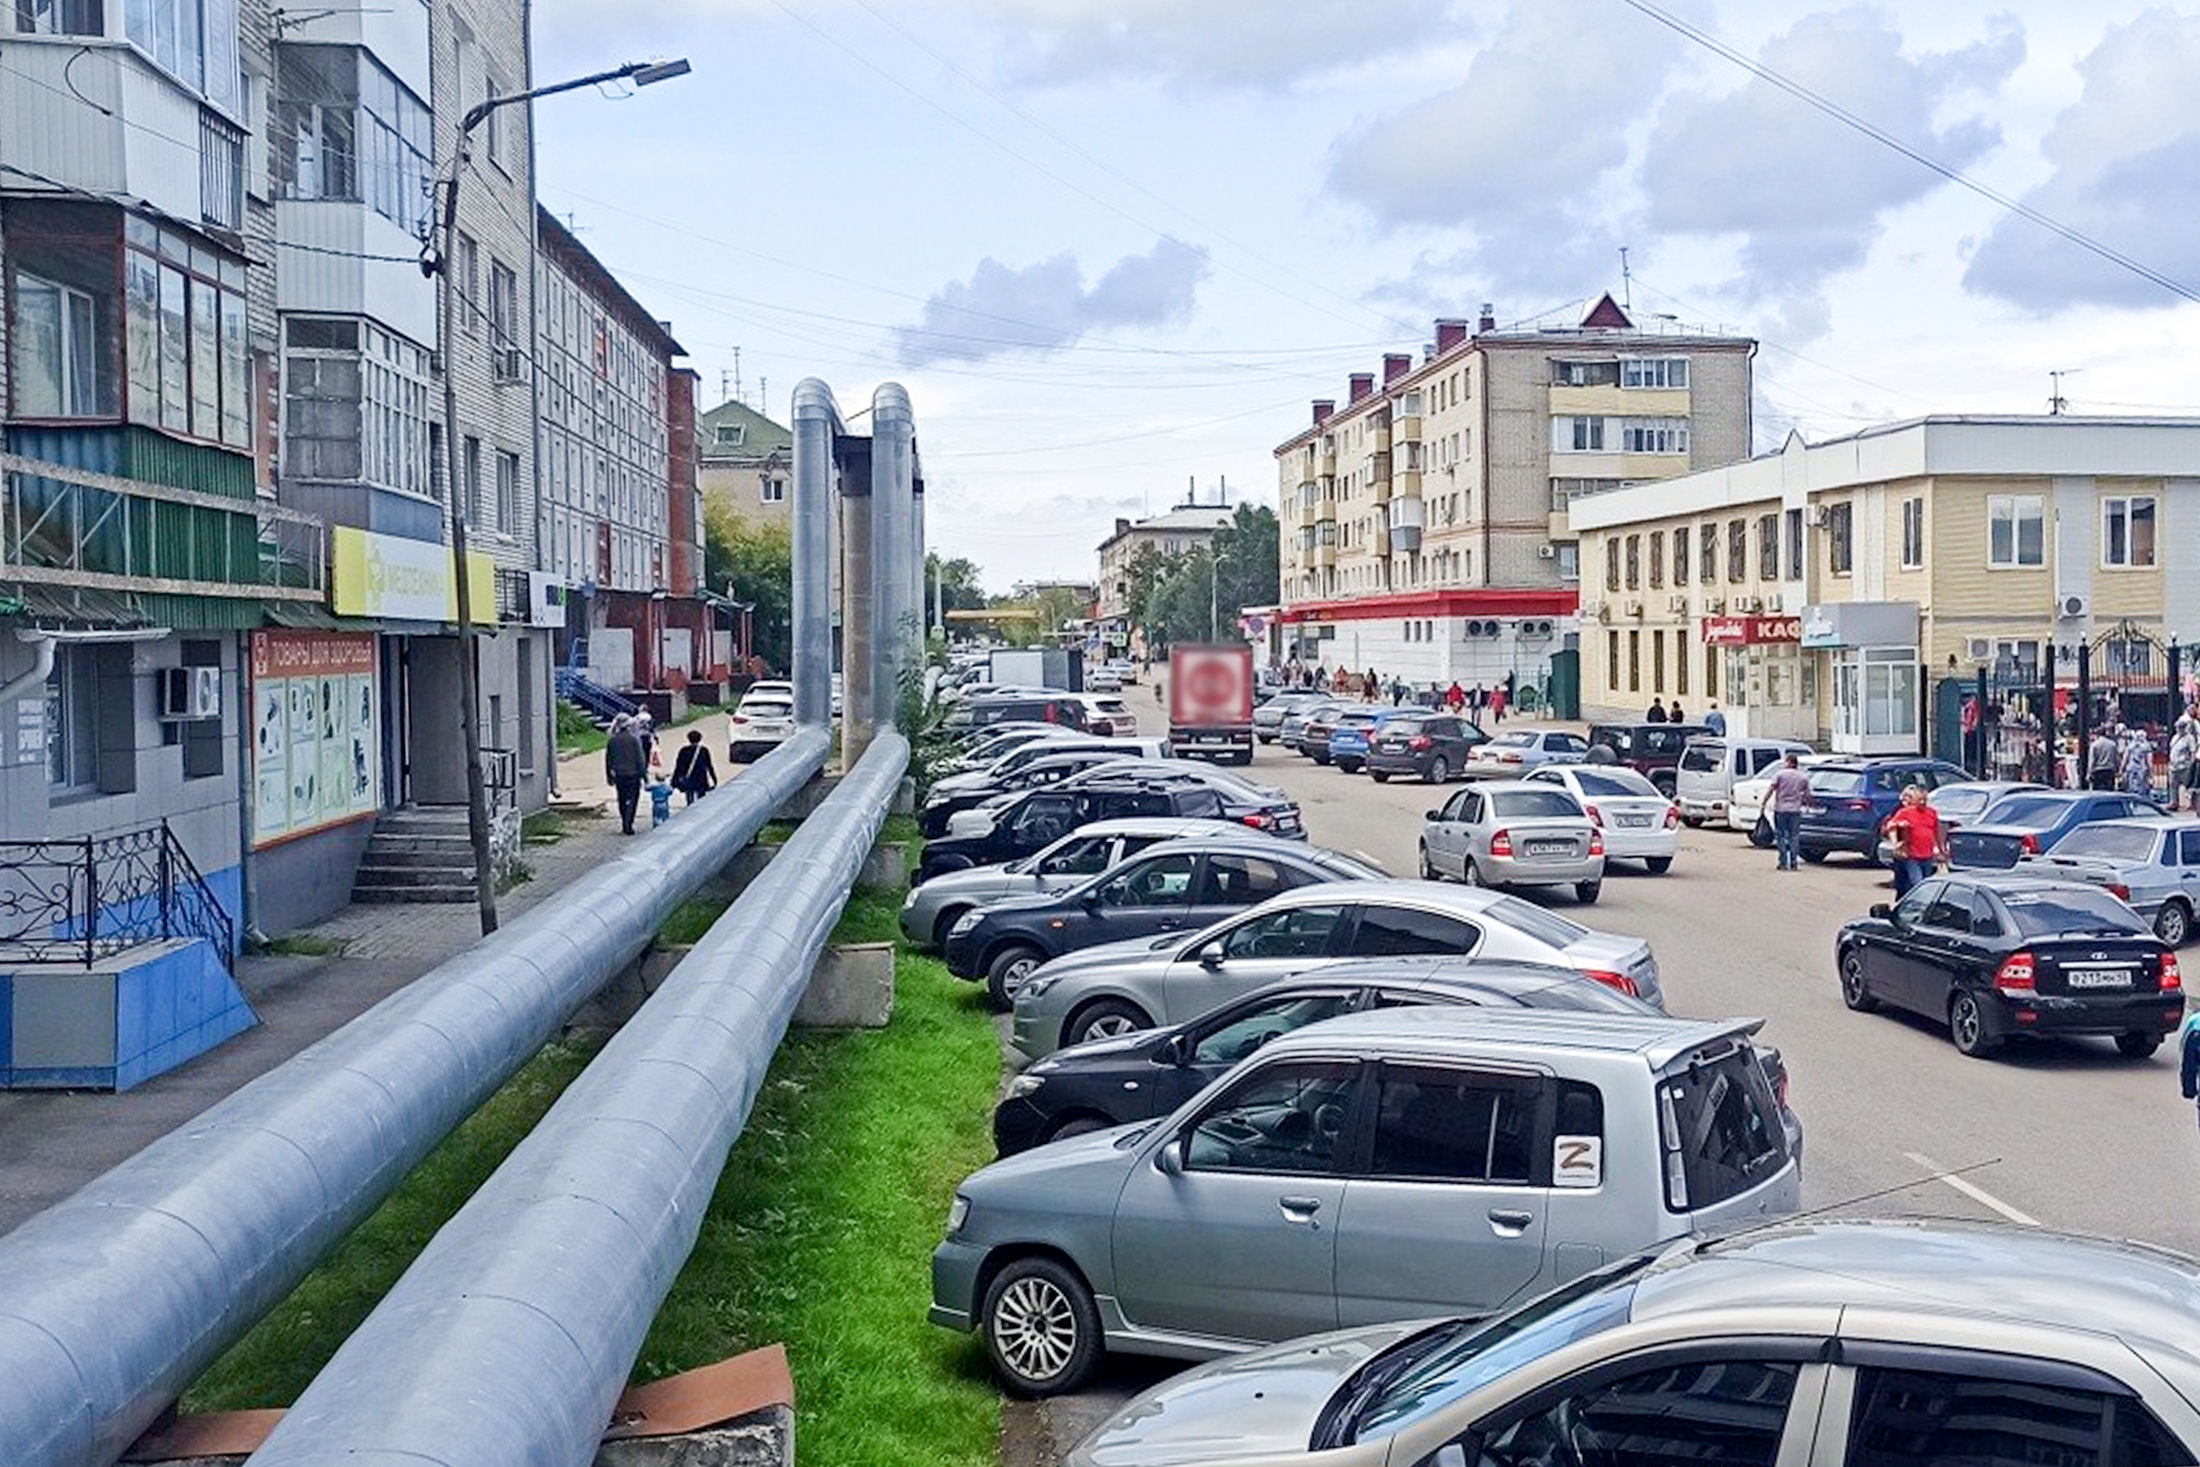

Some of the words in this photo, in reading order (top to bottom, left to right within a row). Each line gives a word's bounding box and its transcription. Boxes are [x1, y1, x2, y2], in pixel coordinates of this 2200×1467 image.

[271, 641, 310, 666] ТОВАРЫ
[312, 641, 329, 665] ДЛЯ
[330, 640, 372, 664] ЗДОРОВЬЯ
[1559, 1142, 1595, 1170] Z
